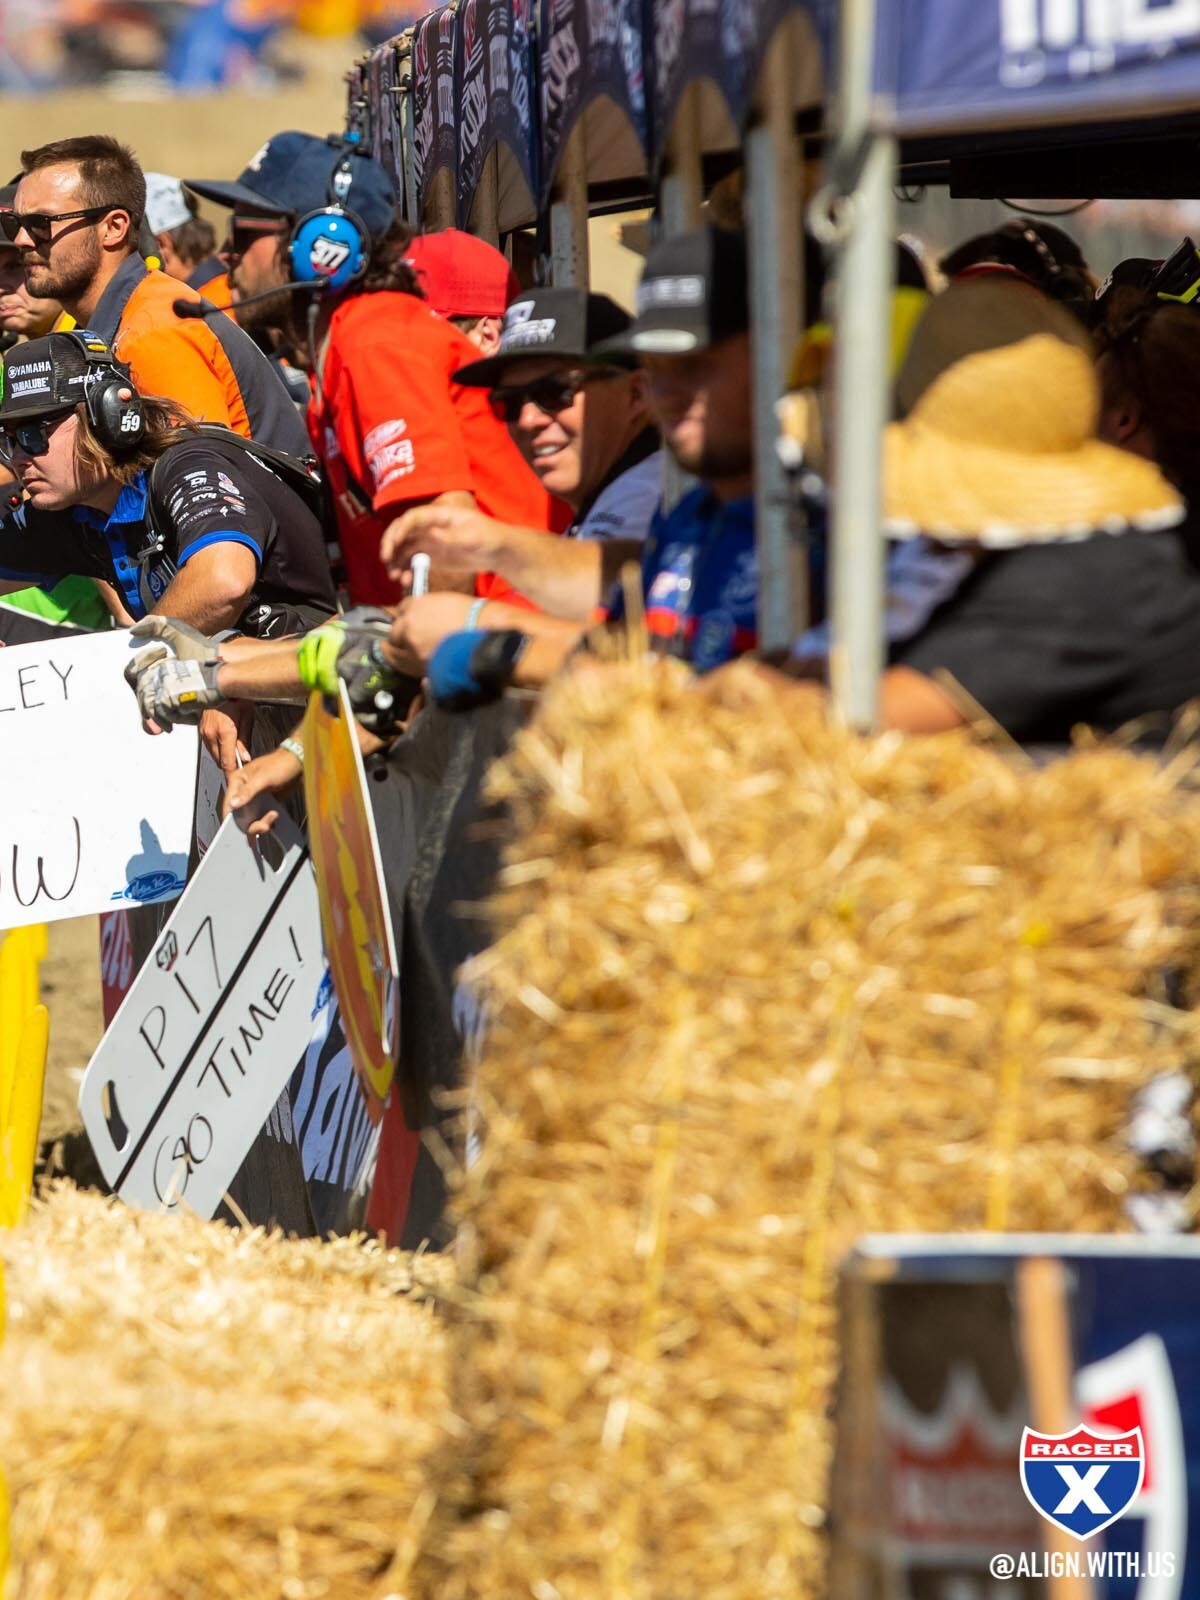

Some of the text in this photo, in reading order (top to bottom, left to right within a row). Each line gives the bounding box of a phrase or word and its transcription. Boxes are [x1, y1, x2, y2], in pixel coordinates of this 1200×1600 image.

[310, 239, 349, 268] 377
[16, 361, 52, 376] YAMAHA
[11, 377, 49, 393] YAMALUBE
[120, 414, 141, 432] 59
[153, 1112, 213, 1208] GO
